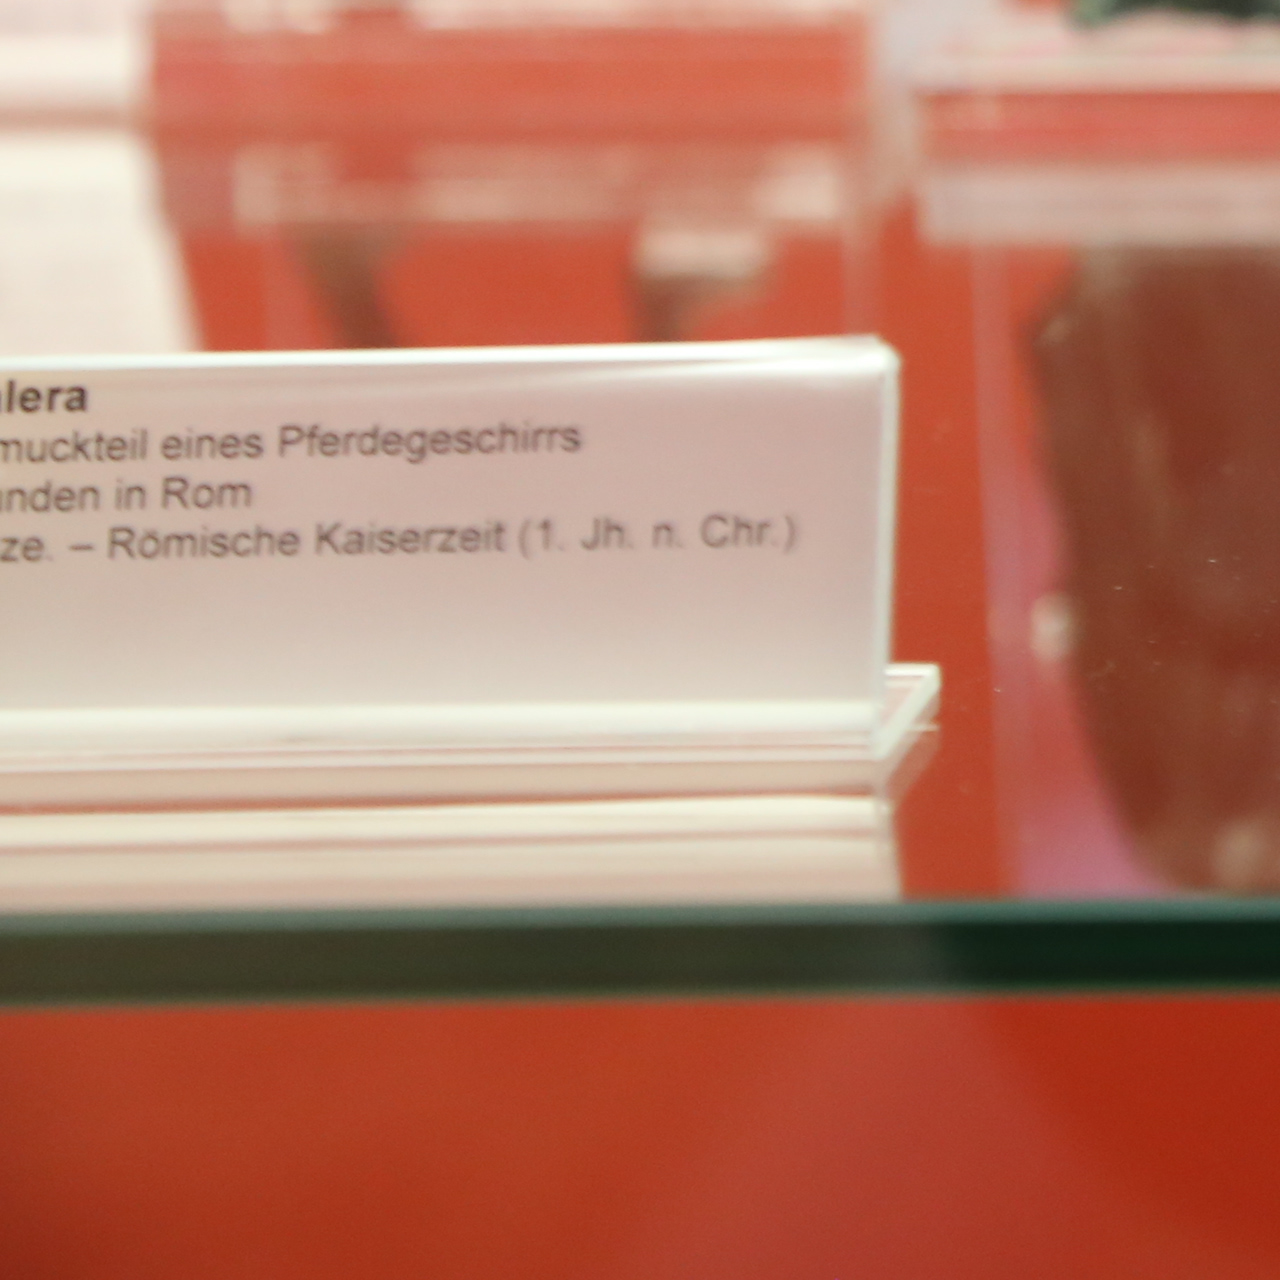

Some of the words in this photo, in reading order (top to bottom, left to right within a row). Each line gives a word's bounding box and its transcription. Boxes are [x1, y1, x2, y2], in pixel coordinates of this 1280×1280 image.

[0, 380, 87, 412] lera
[161, 426, 262, 460] eines
[278, 420, 581, 463] Pferdegeschirrs
[0, 479, 99, 512] nden
[115, 477, 146, 509] in
[161, 476, 251, 509] Rom
[107, 524, 300, 558] Römische
[315, 520, 506, 555] Kaiserzeit
[517, 518, 564, 560] (1.
[581, 517, 635, 550] Jh.
[652, 521, 684, 549] n.
[701, 514, 797, 554] Chr.)
